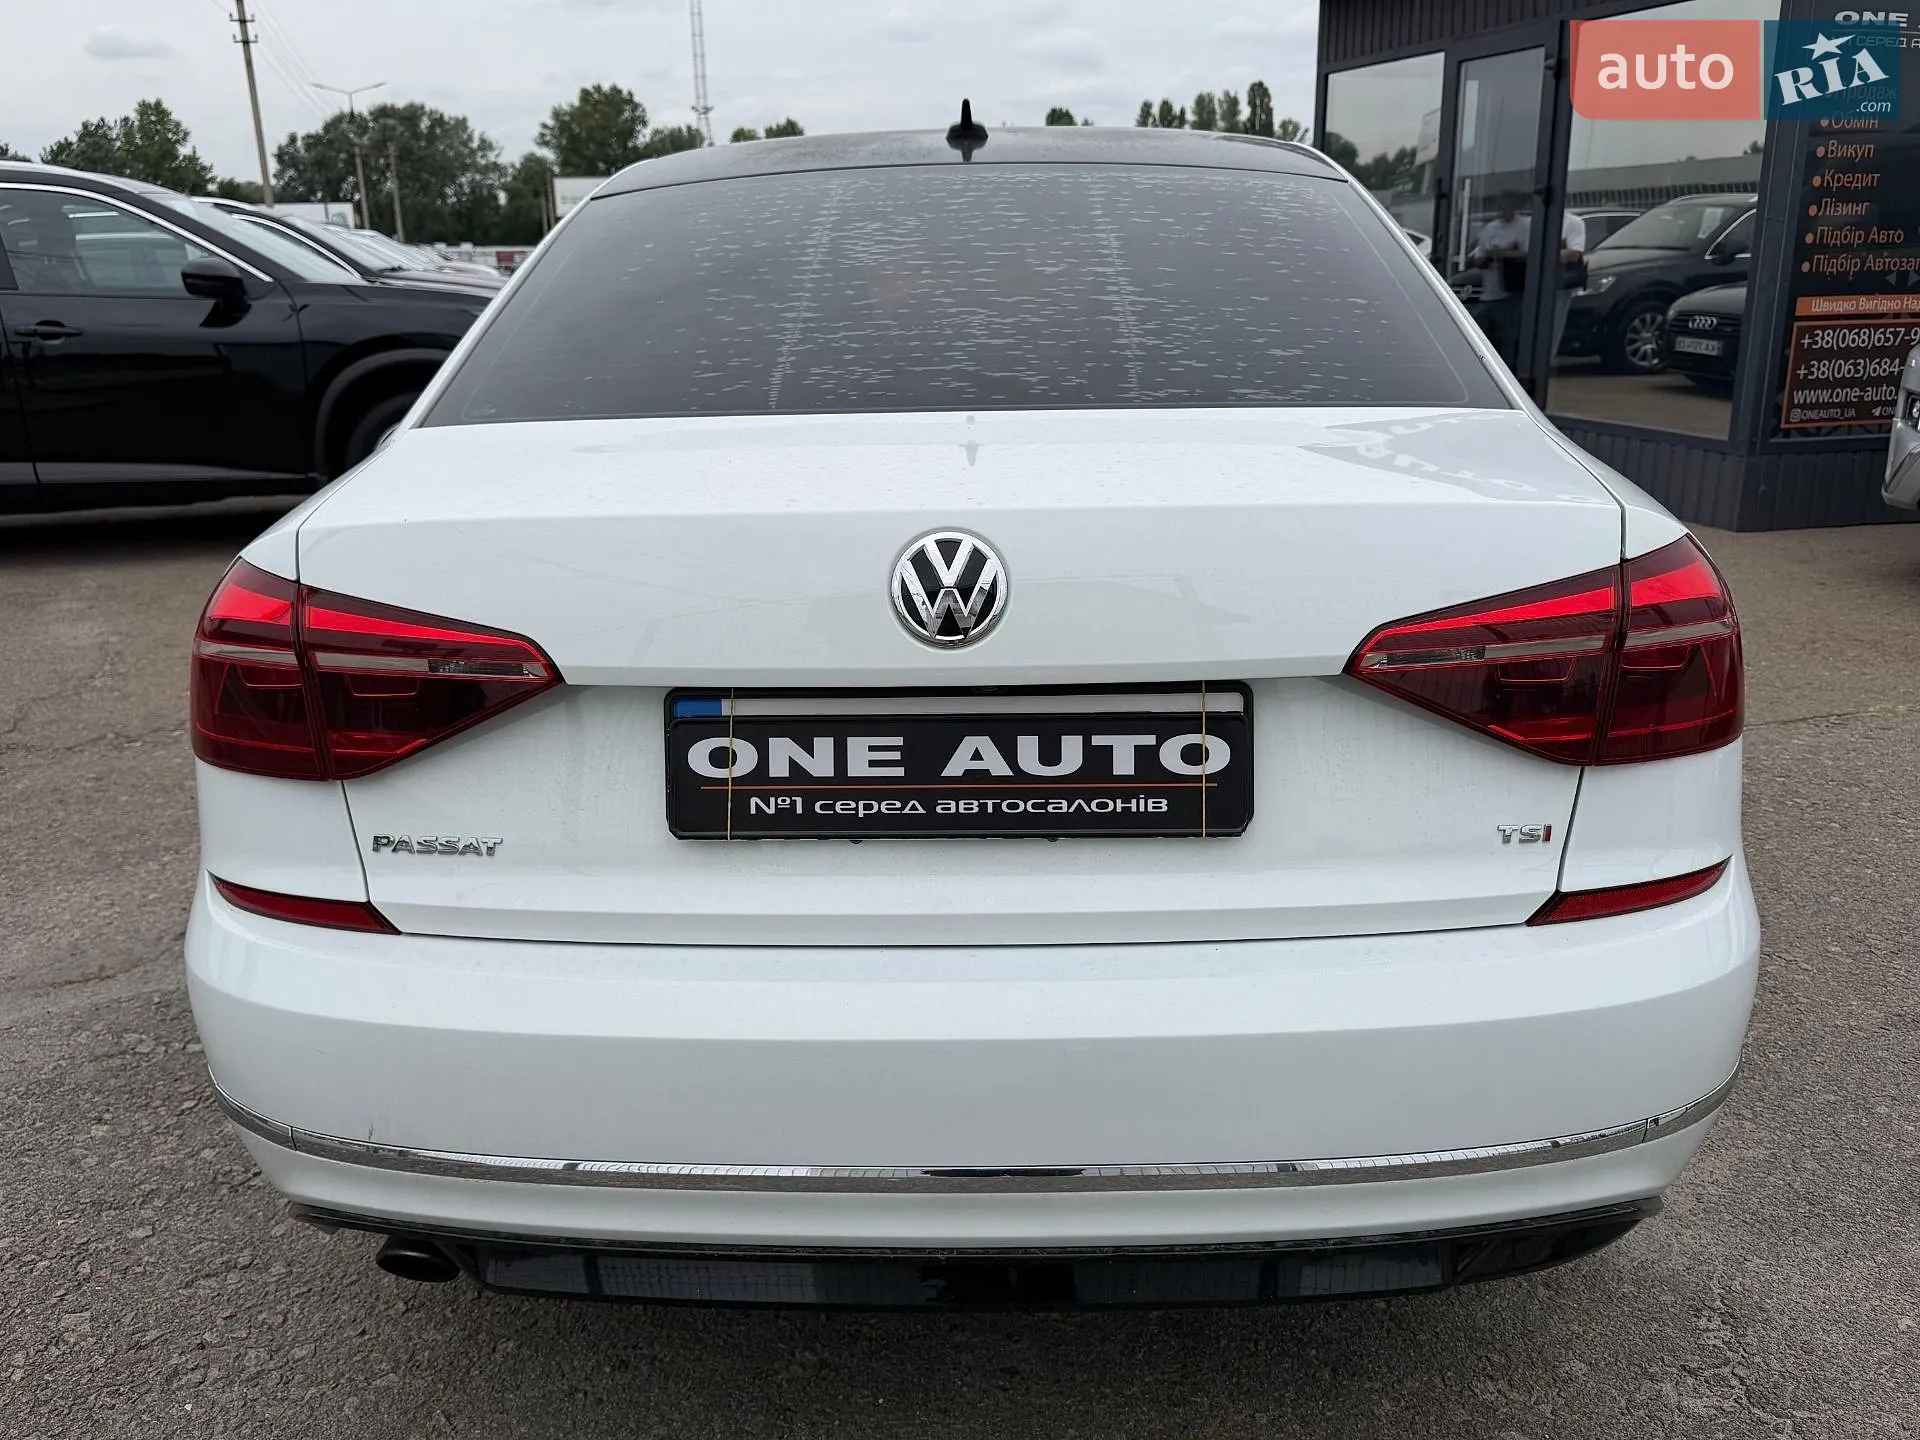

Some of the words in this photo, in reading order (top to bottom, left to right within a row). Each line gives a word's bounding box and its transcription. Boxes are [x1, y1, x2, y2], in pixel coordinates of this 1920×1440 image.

[1834, 10, 1909, 28] ONE
[1832, 110, 1879, 129] Обмін
[1827, 139, 1875, 163] Викуп
[1823, 168, 1881, 192] Кредит
[1818, 197, 1871, 217] Лізинг
[1816, 225, 1865, 248] Підбір
[1867, 225, 1905, 244] Авто
[1812, 252, 1861, 276] Підбір
[1811, 298, 1856, 313] Швидко
[1858, 297, 1901, 312] Вигідно
[687, 736, 905, 779] ONE
[940, 733, 1231, 777] AUTO
[749, 796, 803, 815] №1
[814, 799, 927, 818] серед
[935, 794, 1169, 815] автосалонів
[372, 833, 504, 857] PASSAT
[1497, 824, 1552, 845] TSI
